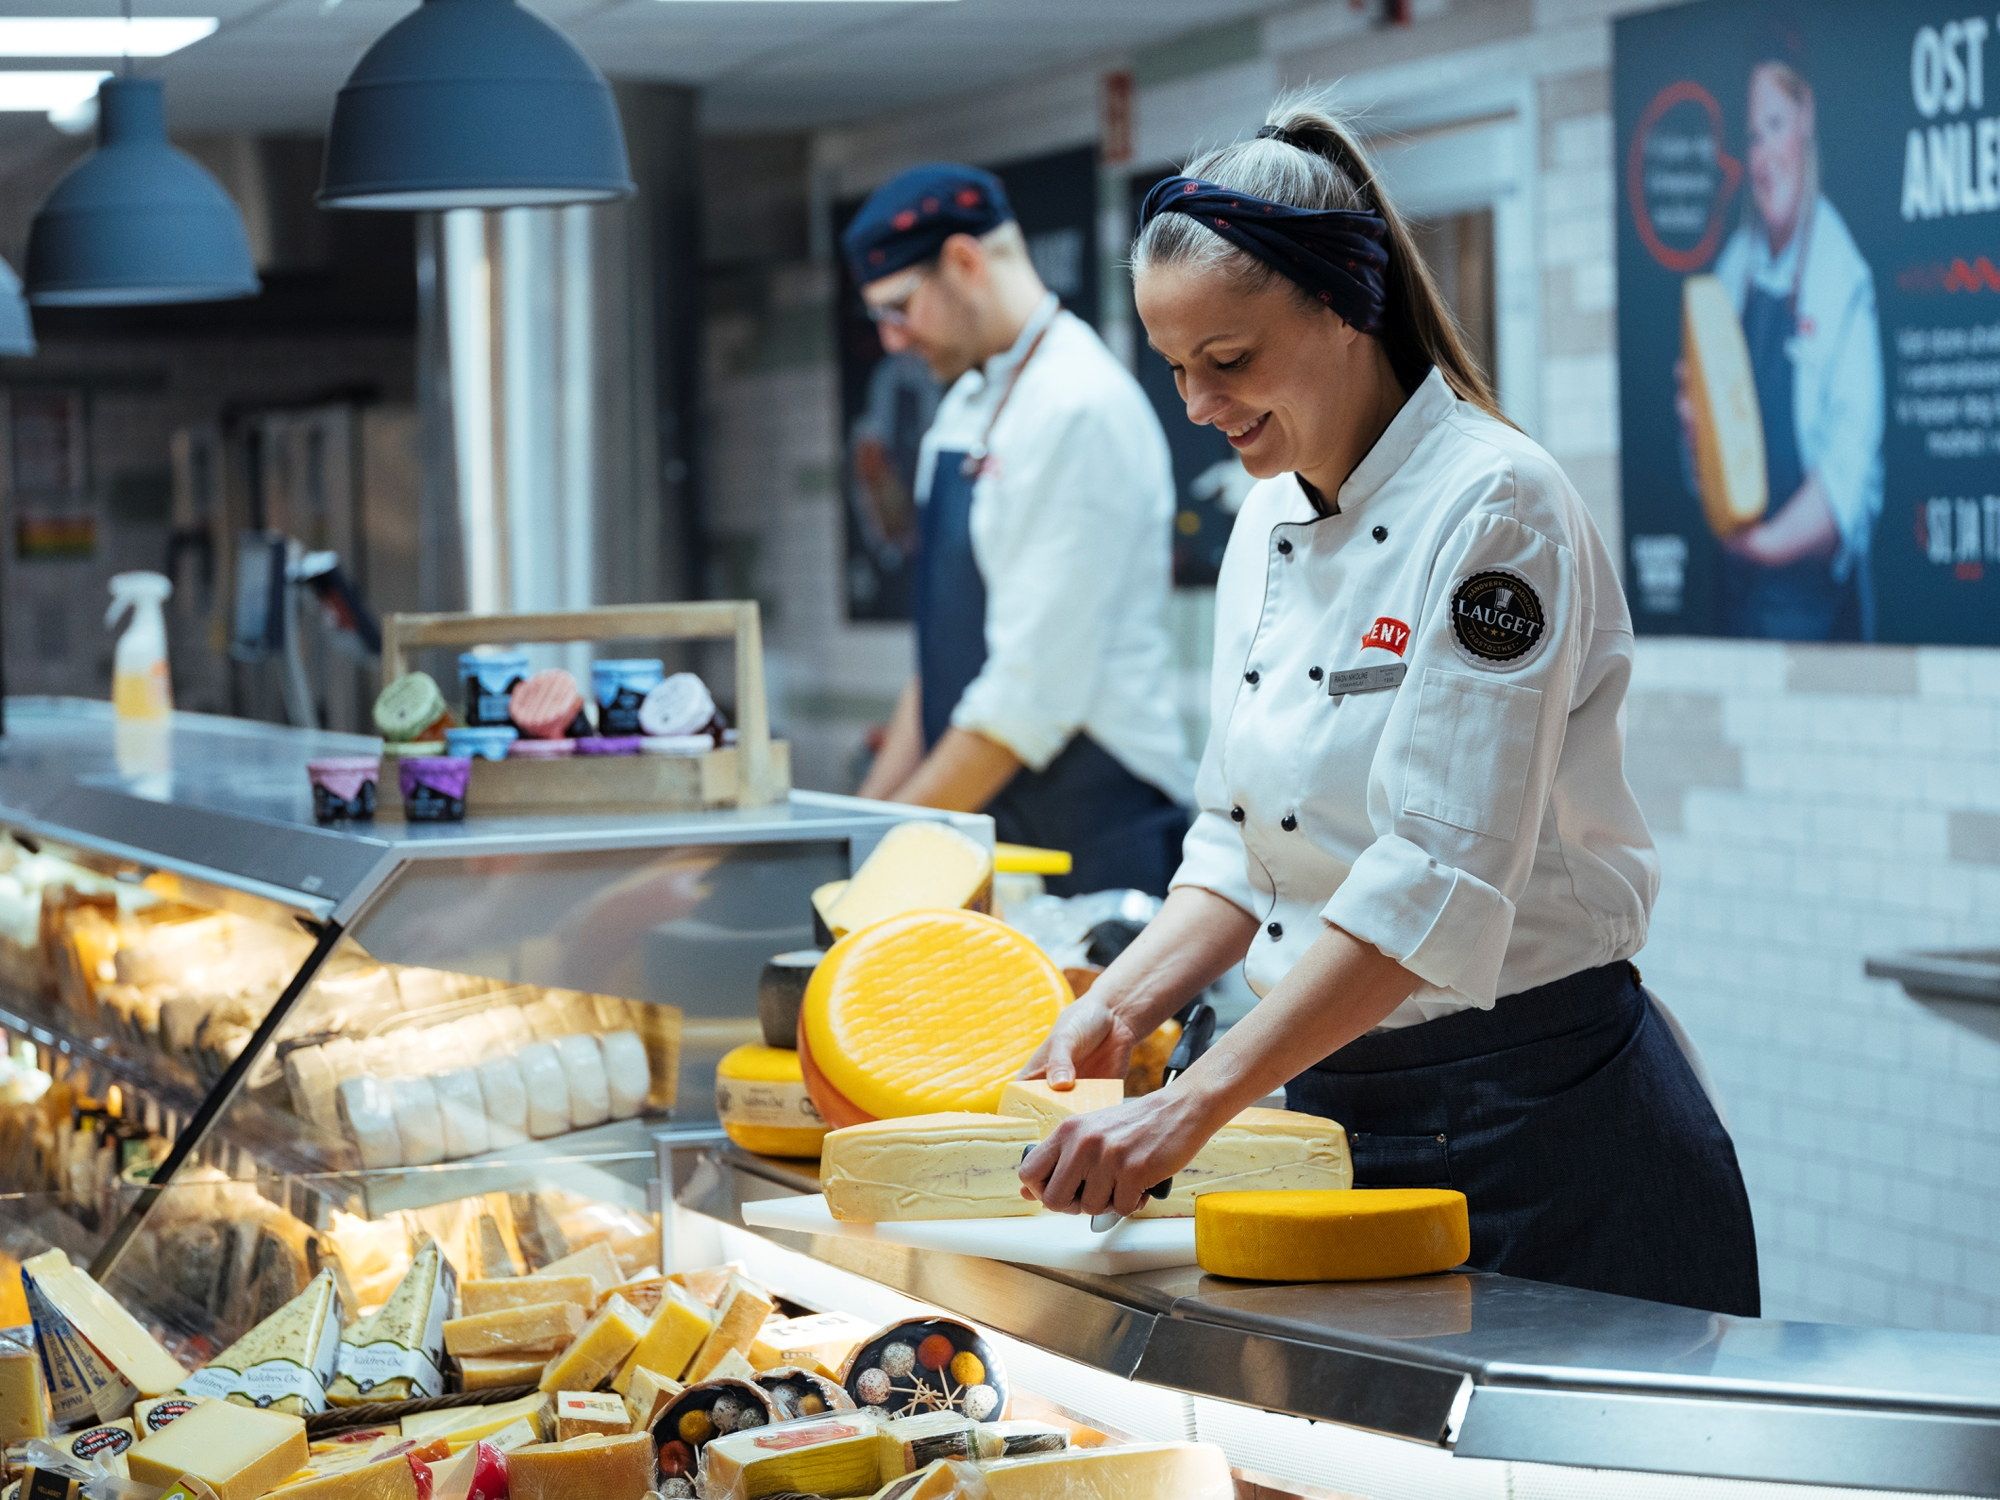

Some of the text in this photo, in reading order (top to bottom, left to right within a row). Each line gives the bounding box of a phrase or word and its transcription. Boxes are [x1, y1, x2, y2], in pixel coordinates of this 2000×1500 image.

[1911, 17, 1988, 118] OST
[1370, 623, 1407, 646] ENY
[1457, 598, 1540, 637] LAUGET
